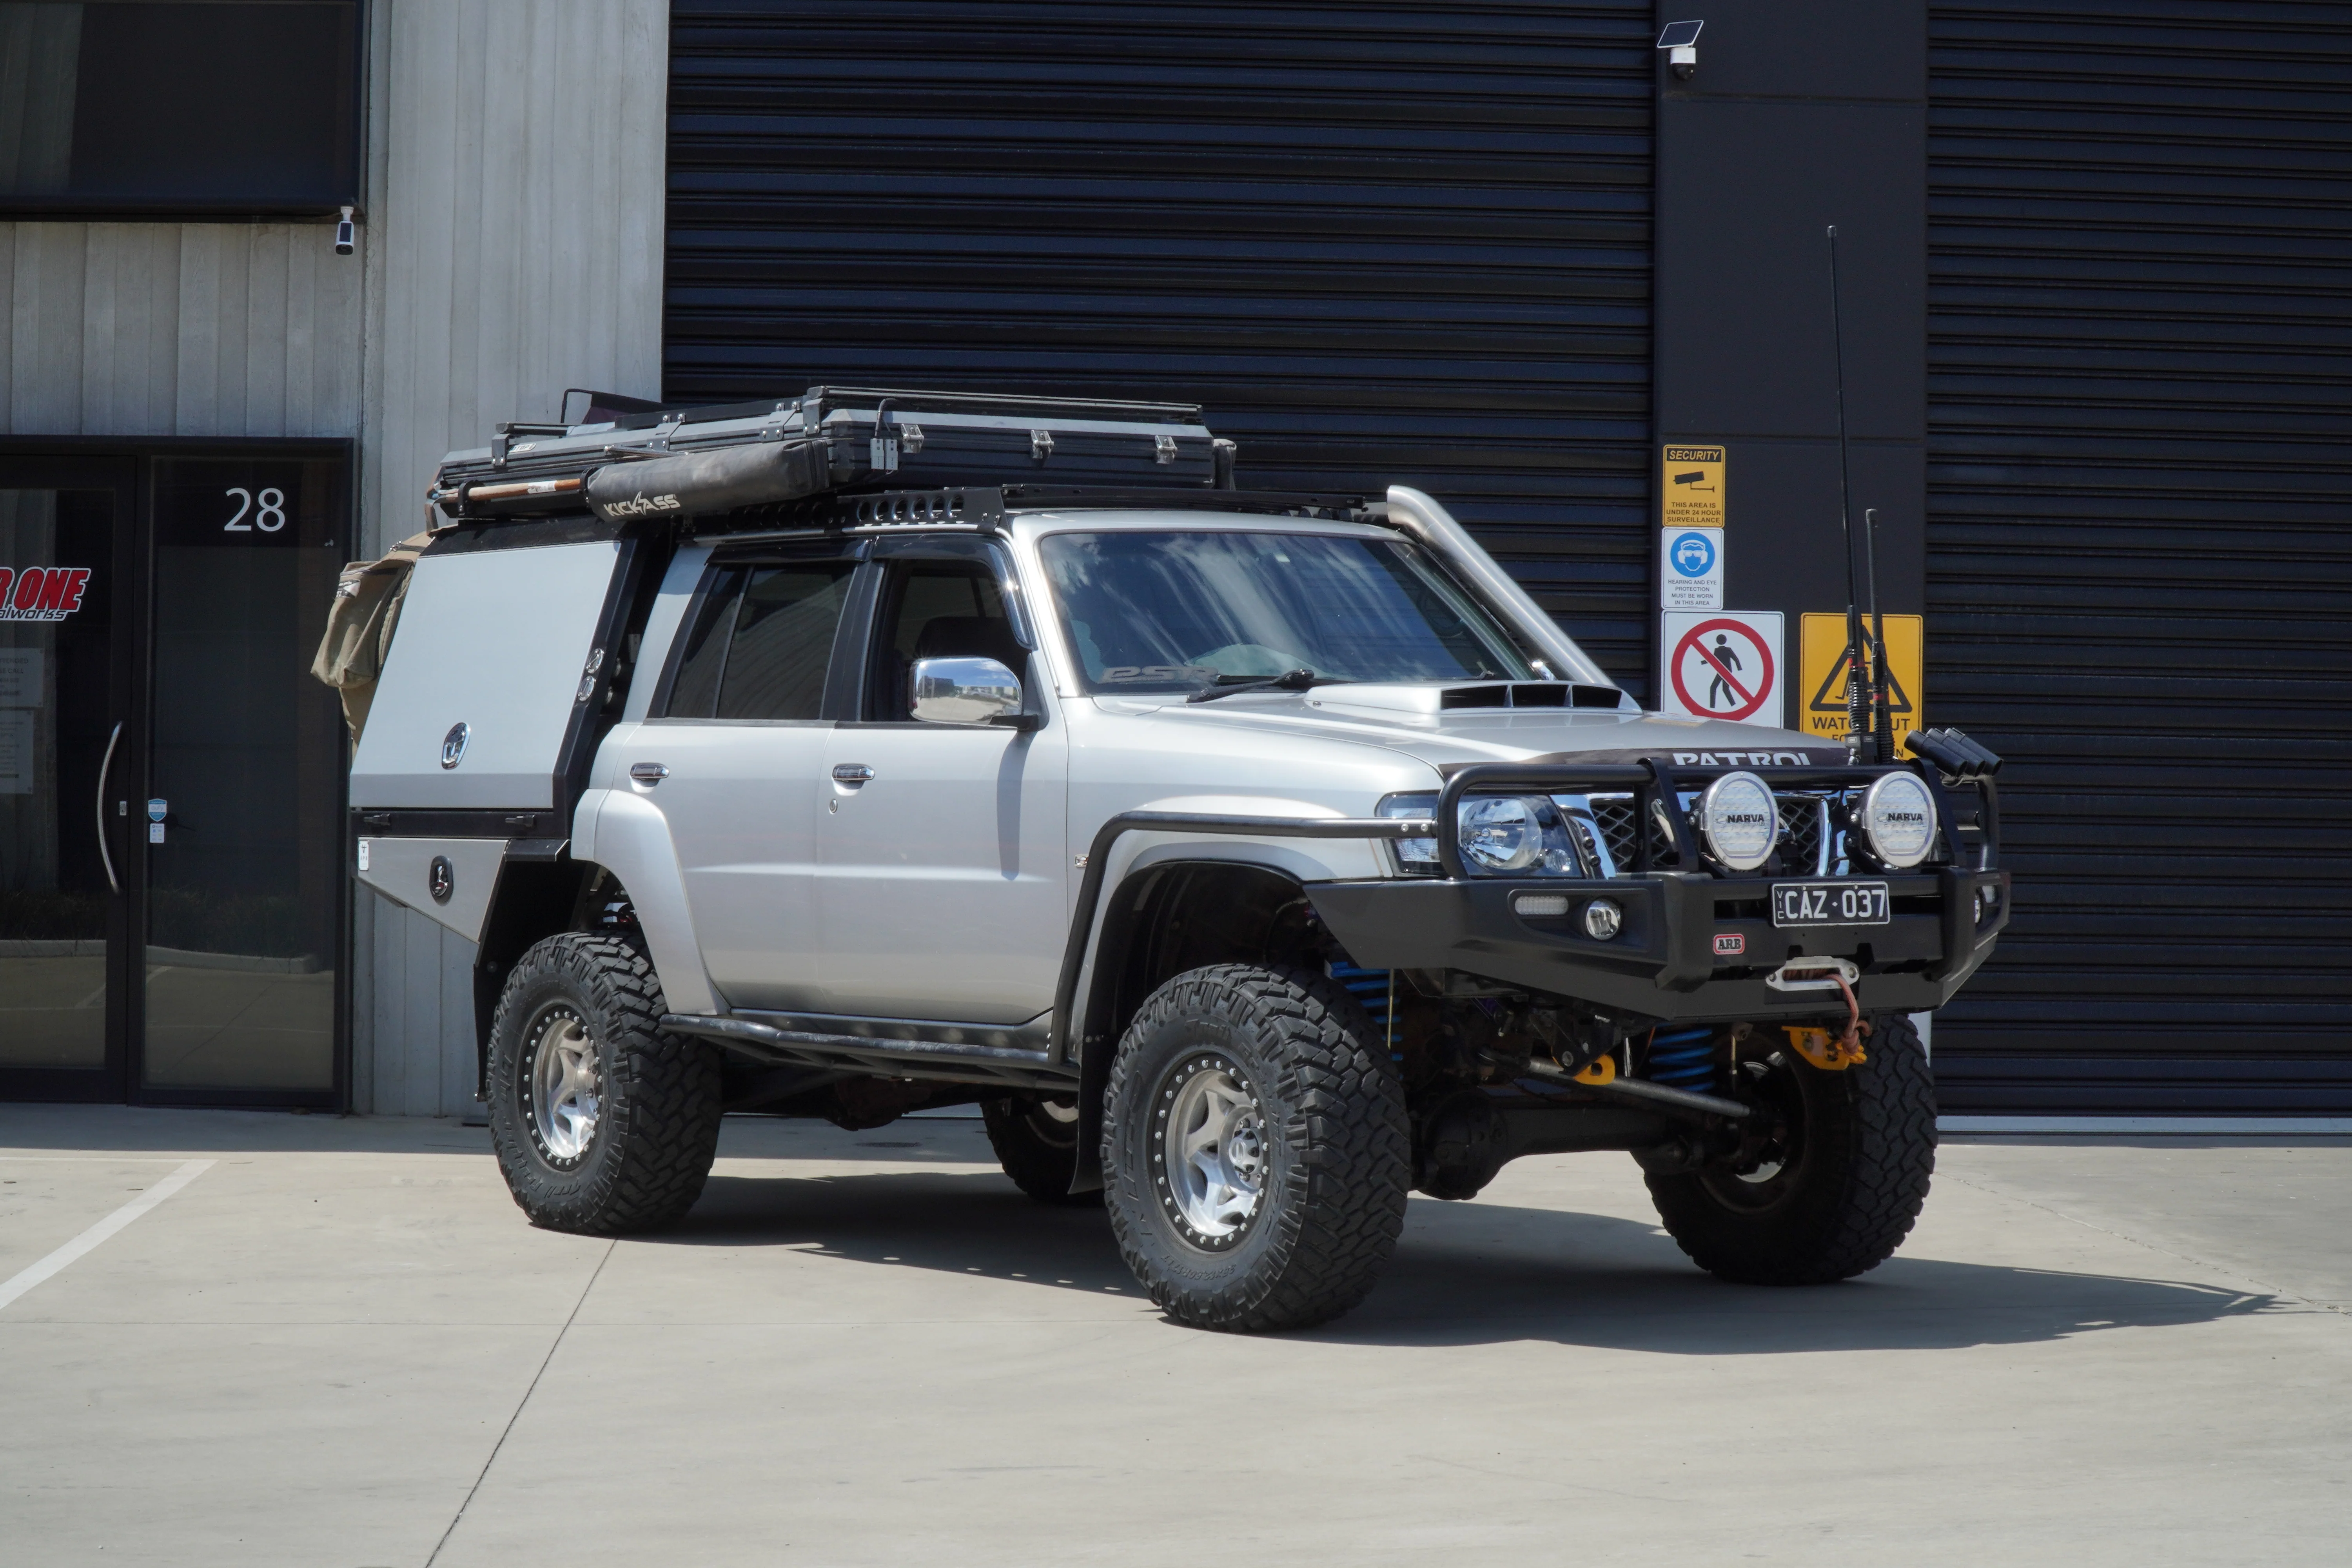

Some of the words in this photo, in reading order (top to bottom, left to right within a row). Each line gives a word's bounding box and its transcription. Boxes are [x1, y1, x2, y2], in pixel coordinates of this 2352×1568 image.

[1669, 450, 1719, 461] SECURITY
[224, 487, 285, 532] 28
[14, 569, 89, 610] ONE
[1812, 717, 1860, 730] WAT
[1728, 814, 1764, 823] NARVA
[1776, 891, 1784, 919] VIC
[1717, 938, 1741, 950] ARB
